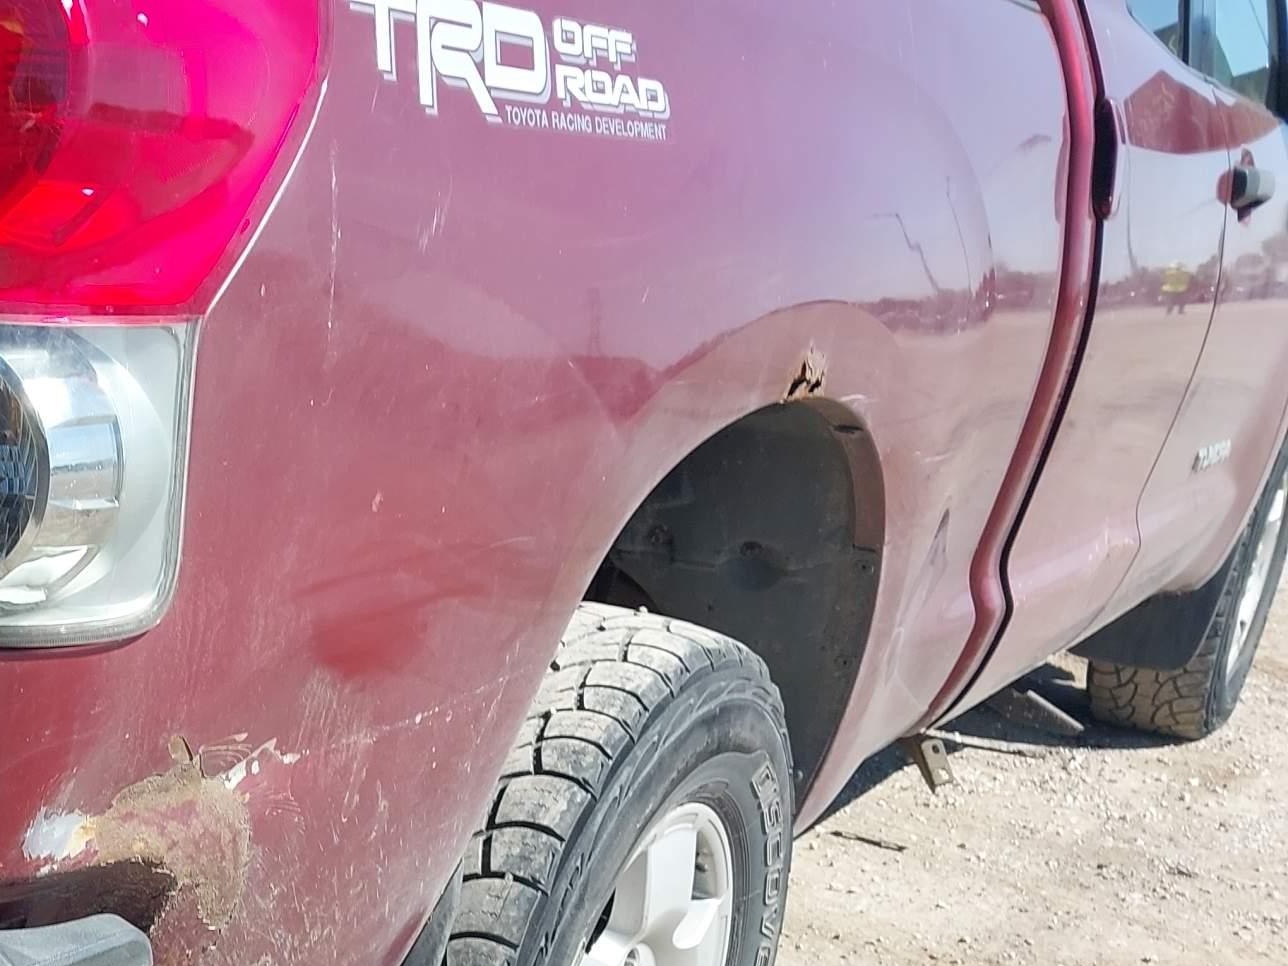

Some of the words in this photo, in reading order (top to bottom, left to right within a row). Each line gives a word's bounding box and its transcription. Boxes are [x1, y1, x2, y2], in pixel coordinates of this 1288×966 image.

[349, 0, 551, 122] TRD
[552, 17, 638, 70] OFF
[554, 63, 670, 120] ROAD
[505, 104, 550, 129] TOYOTA
[551, 110, 593, 134] RACING
[595, 114, 667, 141] DEVELOPMENT
